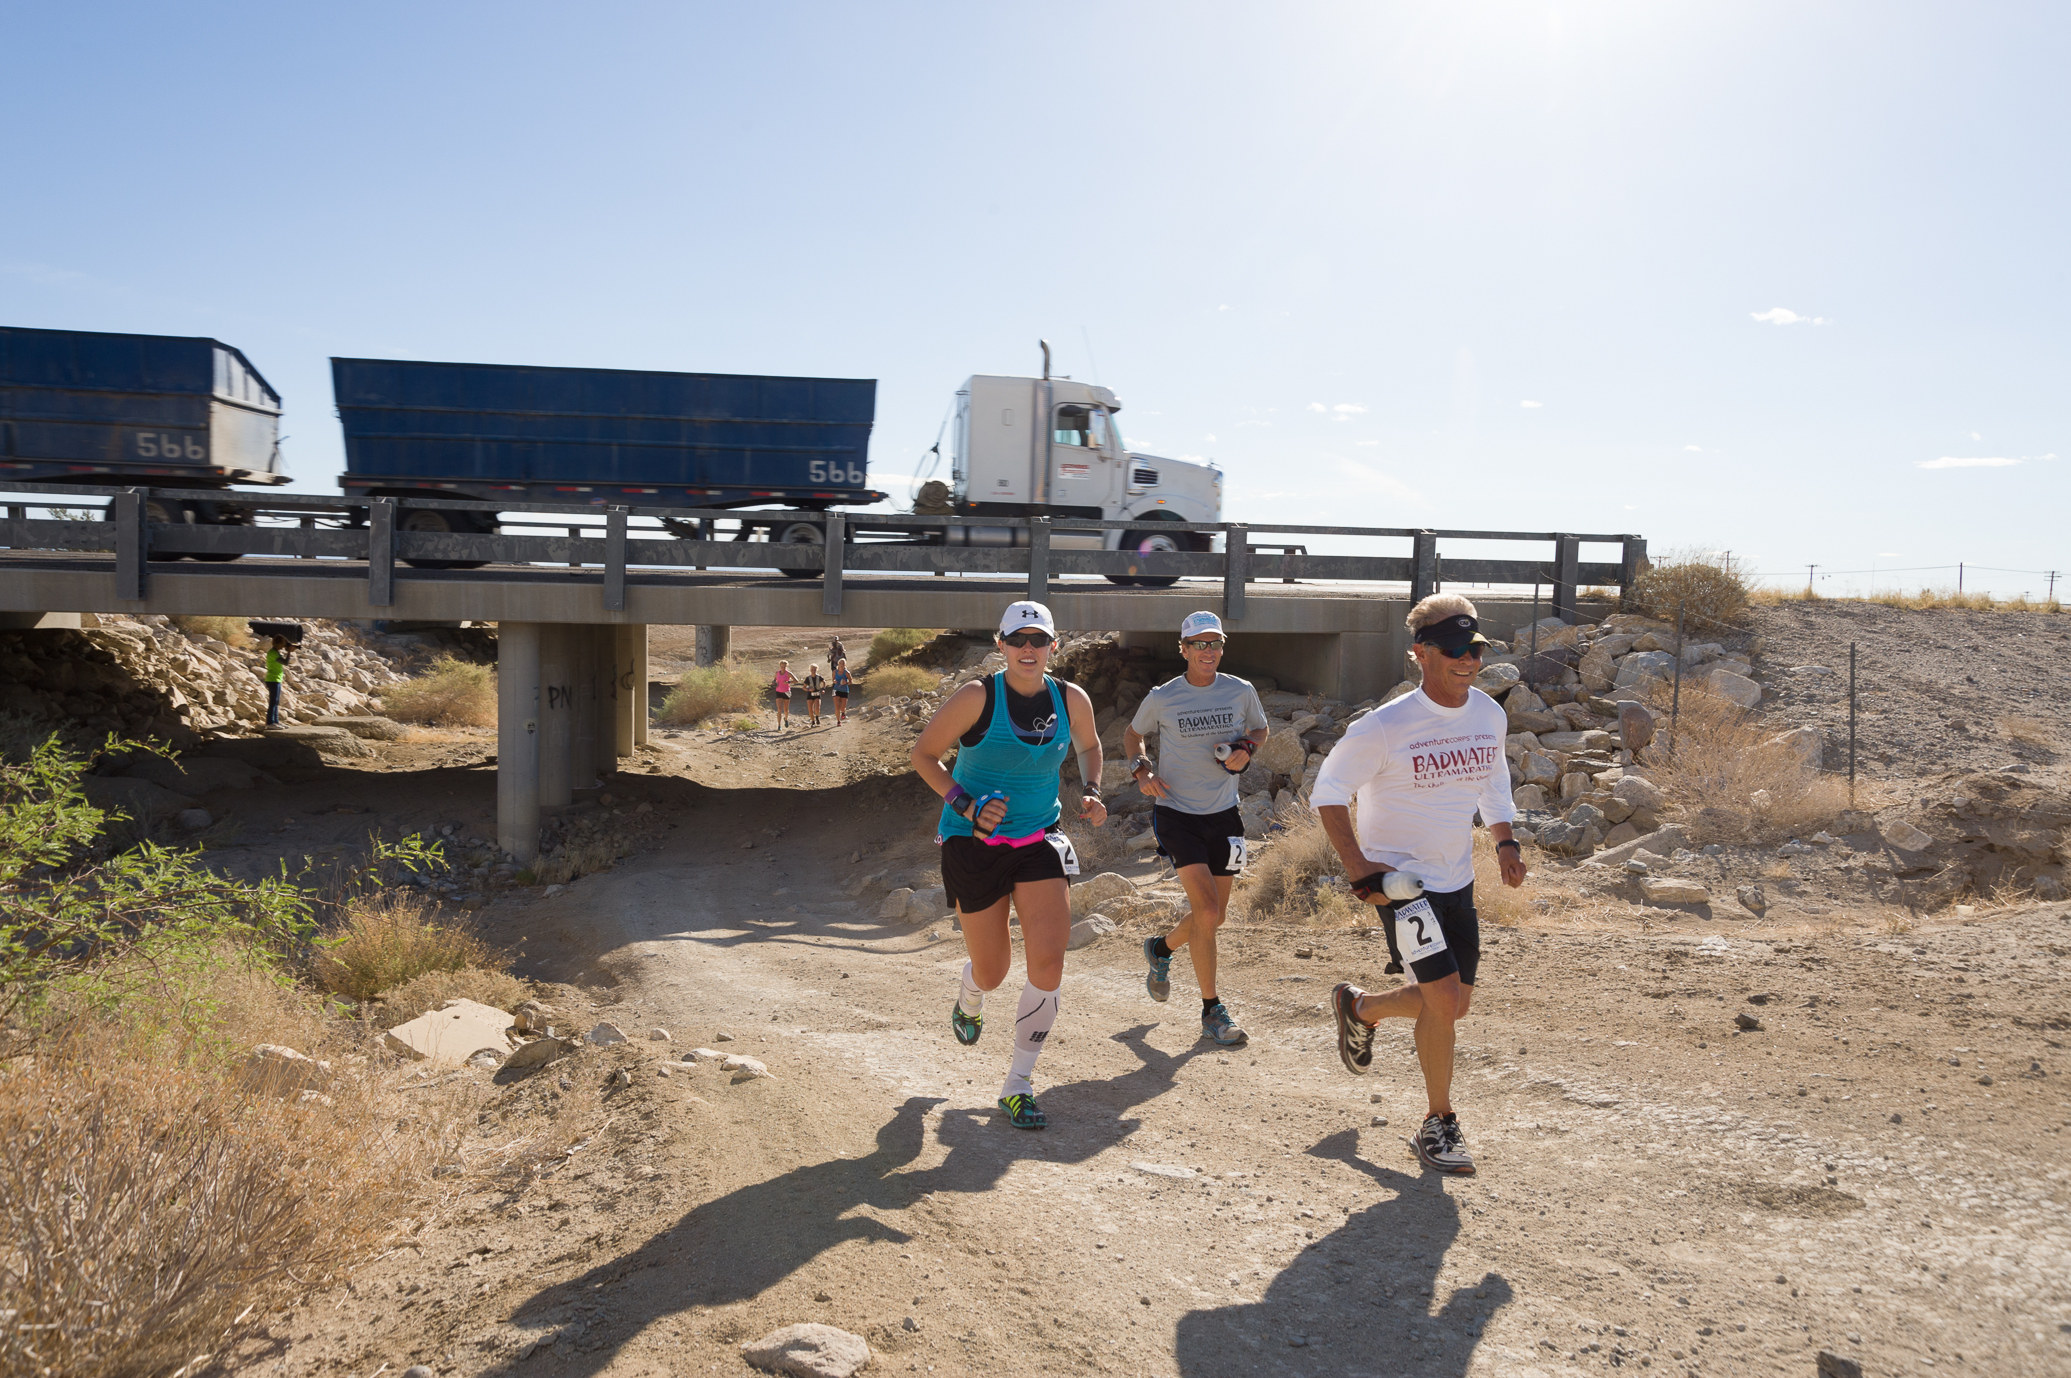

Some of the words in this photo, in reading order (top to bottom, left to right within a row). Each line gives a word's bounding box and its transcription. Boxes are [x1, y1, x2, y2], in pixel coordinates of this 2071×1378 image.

[136, 432, 206, 460] 566
[808, 460, 865, 484] 566
[1178, 713, 1234, 729] BADWATER
[1180, 723, 1234, 733] ULTRAMARATHON
[1234, 844, 1242, 864] 2
[1407, 915, 1433, 947] 2
